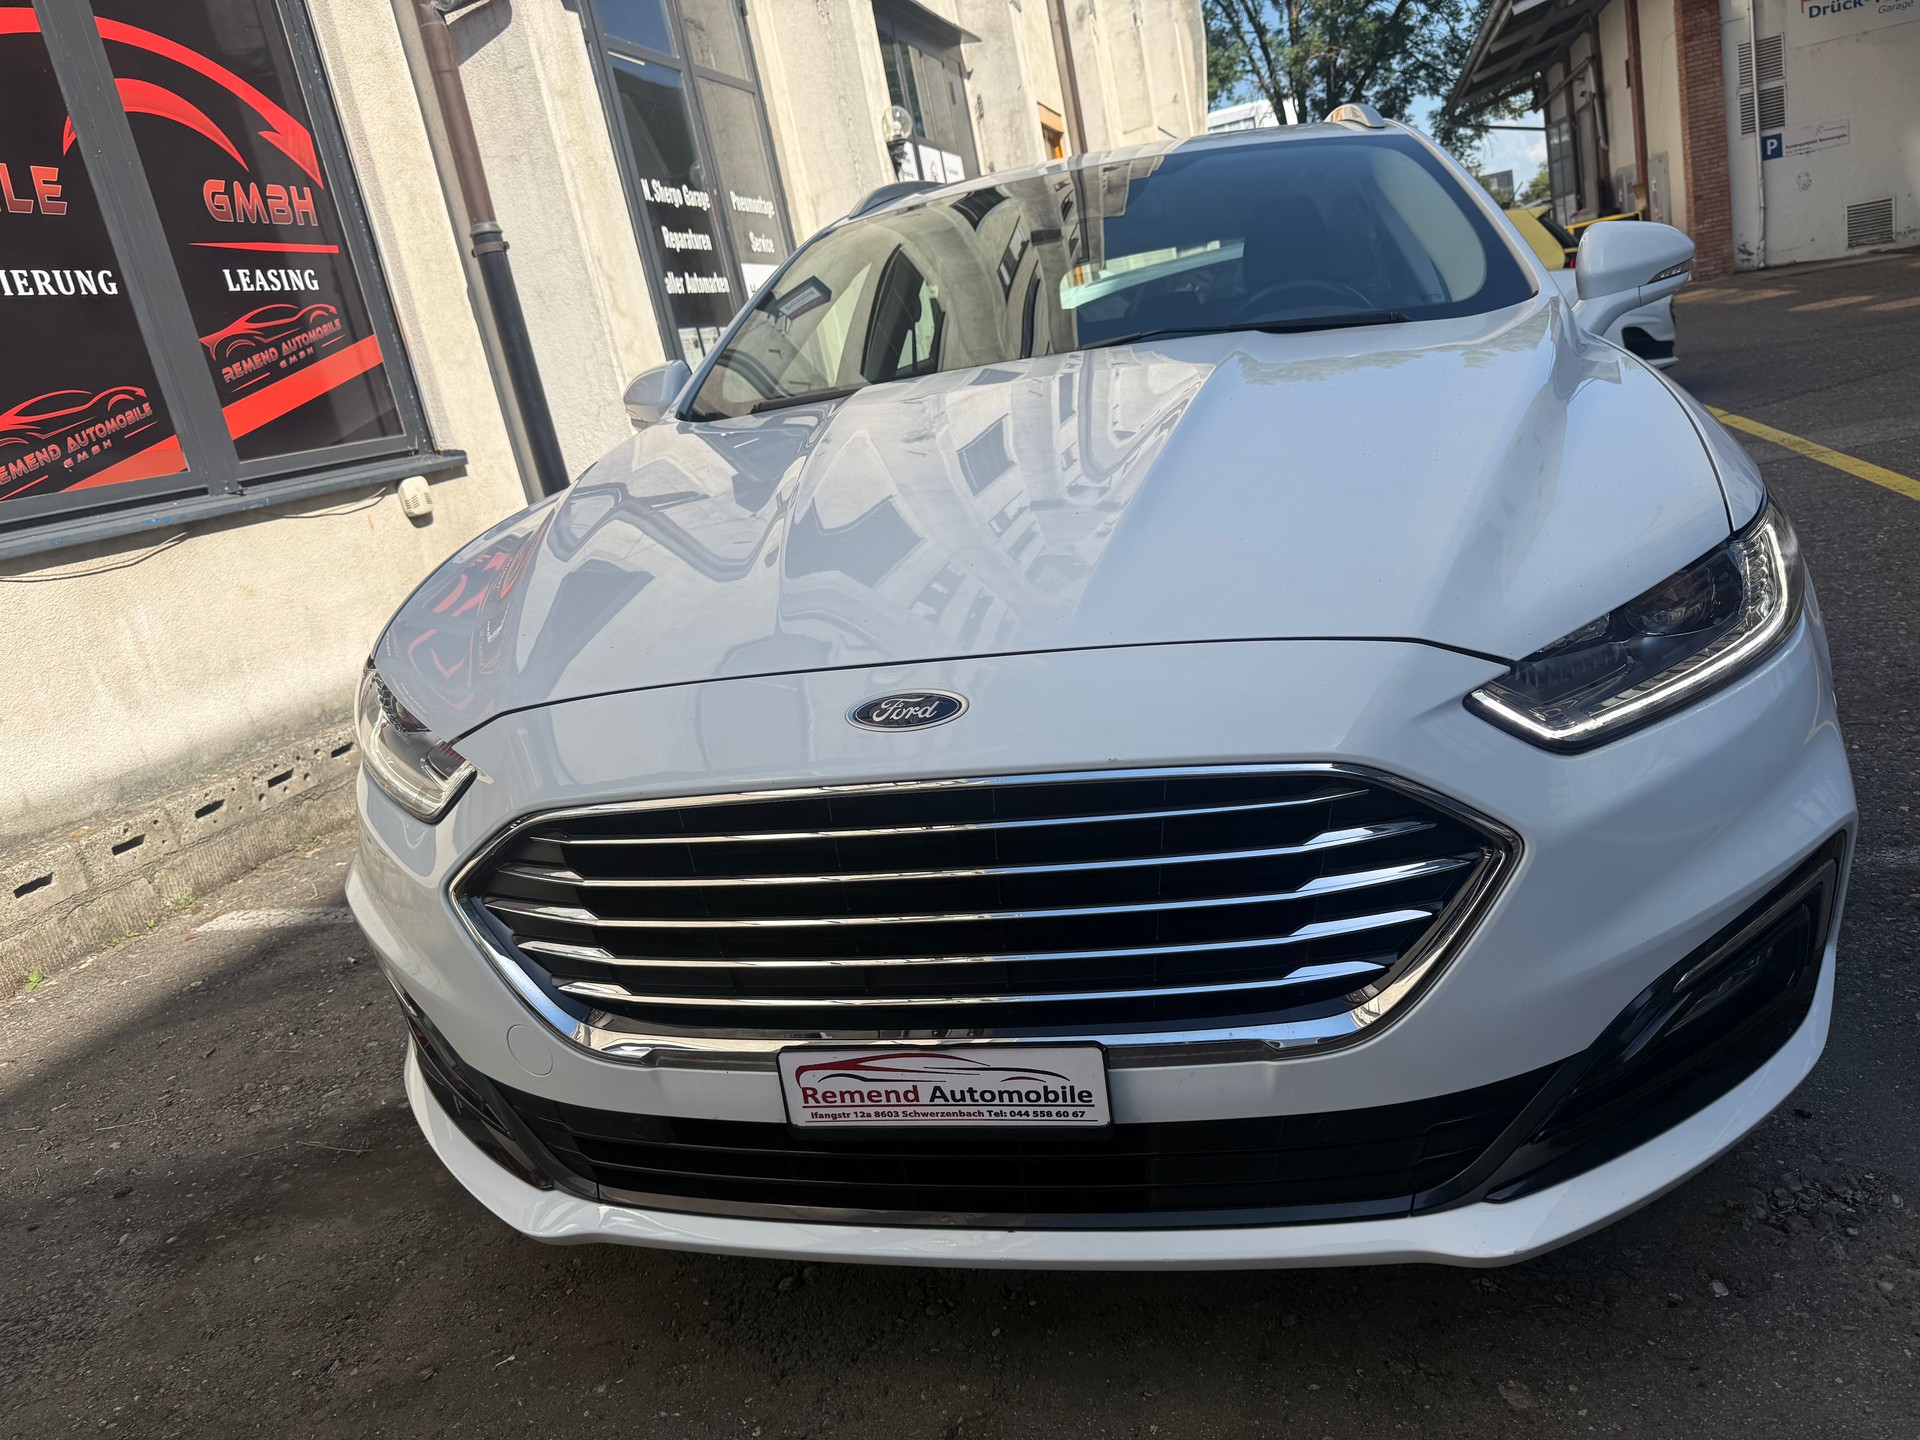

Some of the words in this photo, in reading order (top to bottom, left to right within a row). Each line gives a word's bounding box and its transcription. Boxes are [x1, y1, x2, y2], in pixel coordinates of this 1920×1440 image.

[1877, 0, 1914, 14] Garage
[1766, 138, 1779, 156] P
[203, 179, 319, 227] GMBH
[682, 184, 711, 211] Garage
[730, 190, 775, 219] Pneumontage
[661, 225, 713, 253] Reparaturen
[749, 231, 775, 253] Service
[222, 269, 320, 292] LEASING
[664, 271, 685, 294] aller
[684, 271, 730, 293] Automarken
[221, 347, 279, 383] REMEND
[281, 318, 343, 356] AUTOMOBILE
[67, 402, 153, 454] AUTOMOBILE
[872, 697, 940, 722] Ford
[801, 1085, 920, 1104] Remend
[929, 1085, 1093, 1103] Automobile
[811, 1111, 850, 1120] Ifangstr
[874, 1110, 899, 1118] 8603
[902, 1110, 984, 1118] Schwerzenbach
[986, 1110, 1007, 1118] Tel:
[1009, 1110, 1030, 1118] 044
[1032, 1110, 1052, 1118] 558
[1055, 1110, 1070, 1118] 60
[1072, 1110, 1086, 1118] 67
